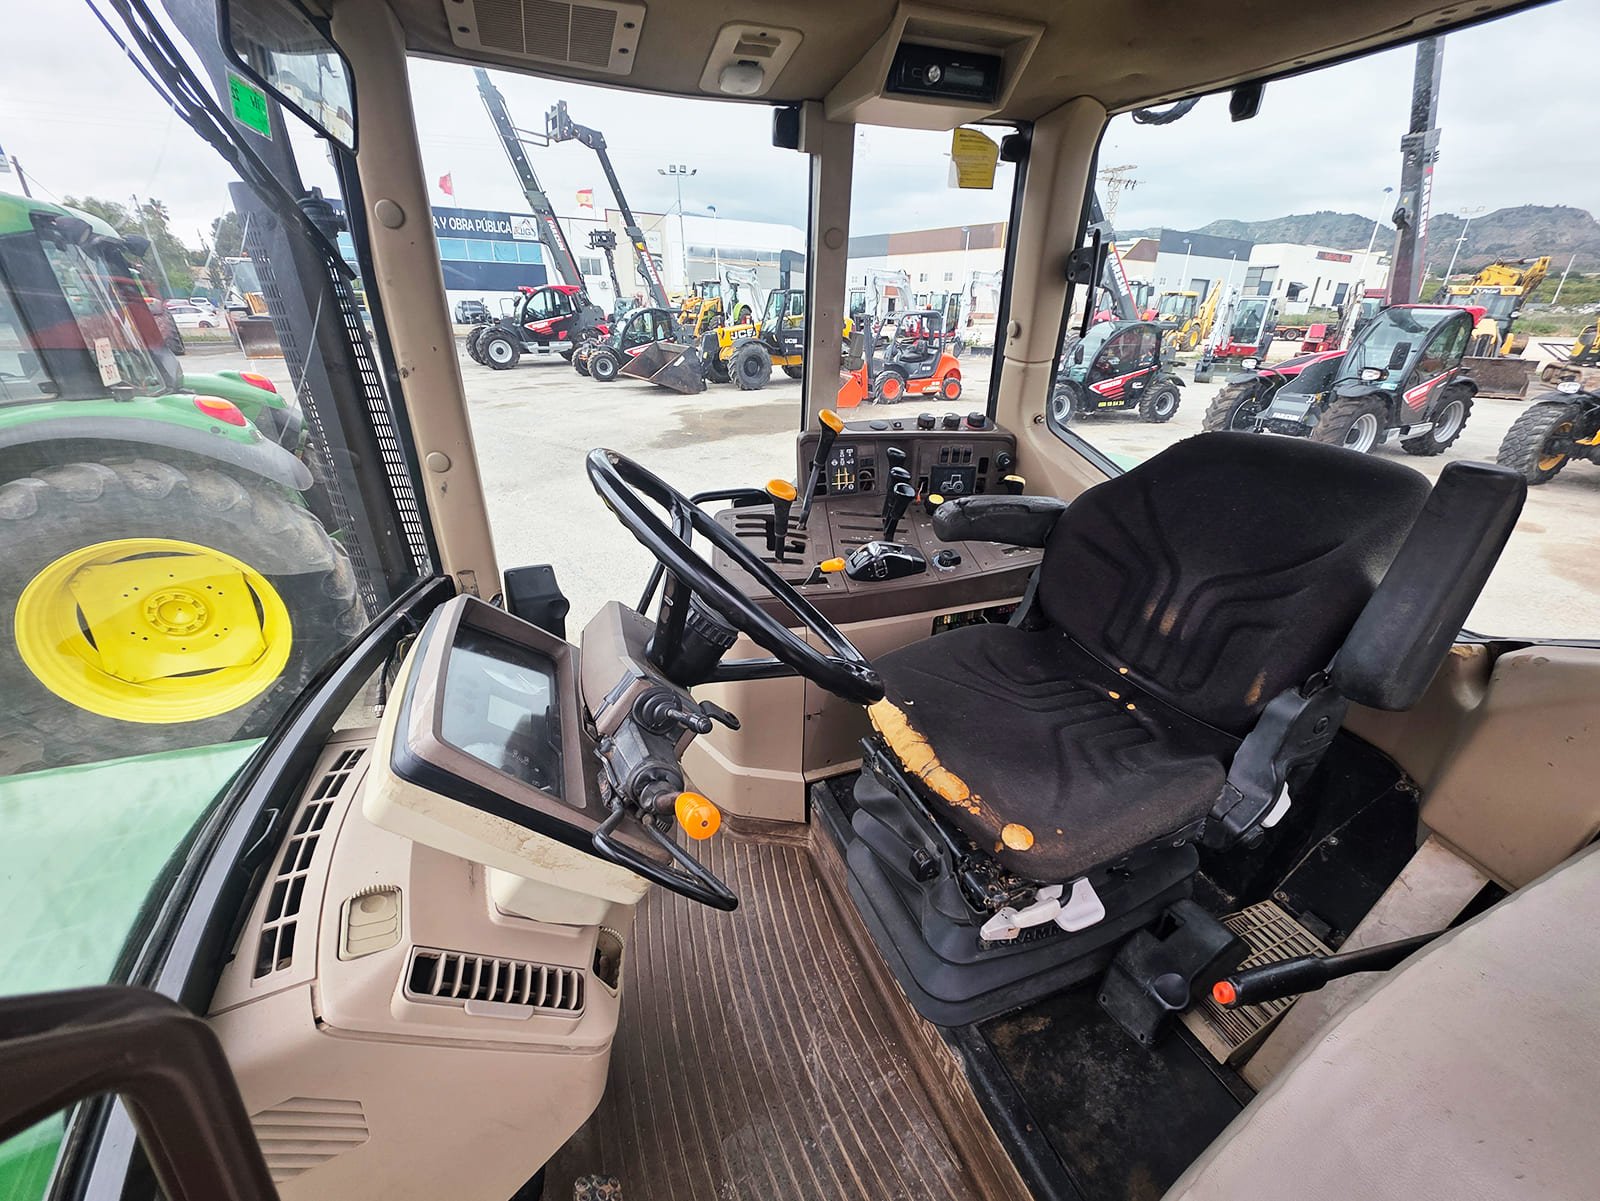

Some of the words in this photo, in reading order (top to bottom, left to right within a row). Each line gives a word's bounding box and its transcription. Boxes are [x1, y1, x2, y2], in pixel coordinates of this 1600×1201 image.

[440, 217, 447, 229] Y
[449, 217, 475, 232] OBRA
[476, 217, 513, 234] PÚBLICA
